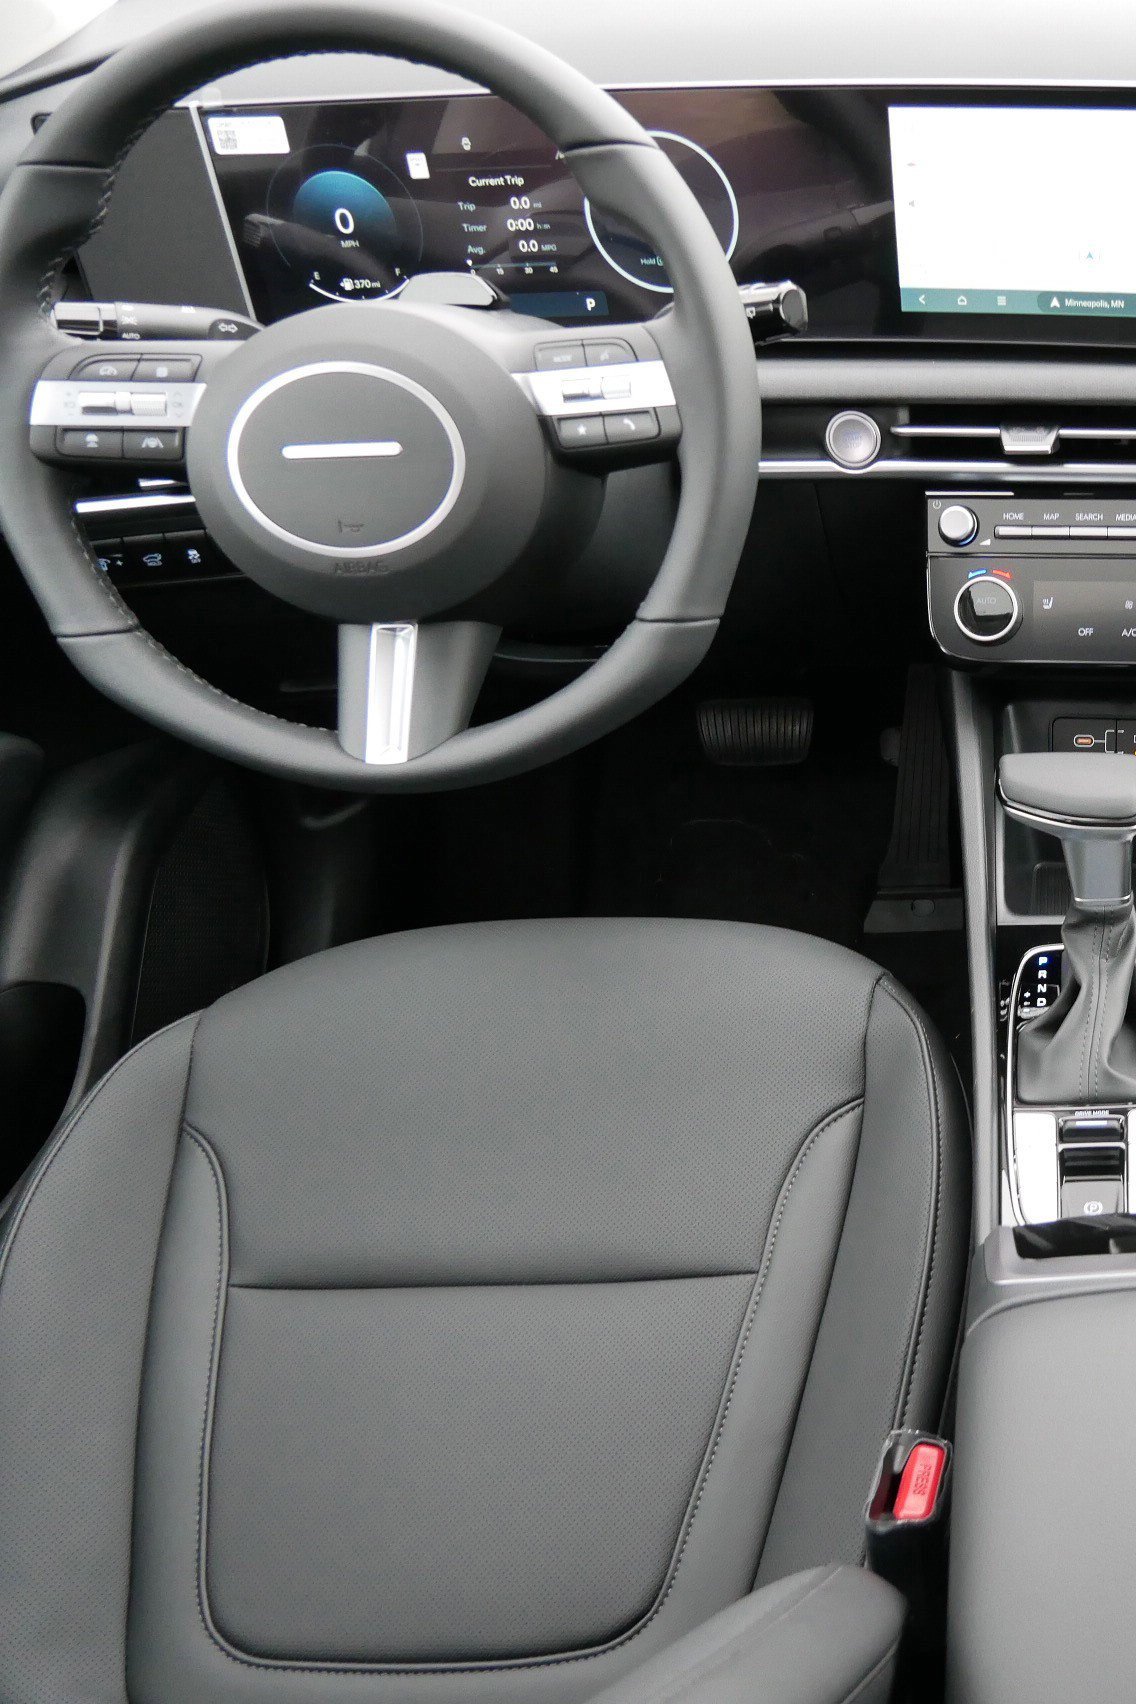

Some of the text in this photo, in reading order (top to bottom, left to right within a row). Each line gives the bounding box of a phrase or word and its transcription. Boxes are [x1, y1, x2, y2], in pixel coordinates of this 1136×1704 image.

[468, 175, 525, 187] Current Trip
[457, 201, 476, 212] Trip
[510, 196, 530, 210] 0.0
[334, 207, 355, 235] 0
[462, 223, 488, 233] Timer
[506, 218, 535, 232] 0:00
[340, 240, 360, 249] MPH
[467, 245, 486, 256] Avg.
[518, 239, 539, 253] 0.0
[355, 279, 372, 290] 370
[585, 297, 597, 312] P
[1065, 298, 1125, 309] Minneapolis, MN
[121, 332, 141, 341] AUTO
[1002, 512, 1025, 521] HOME
[1043, 512, 1060, 521] MAP
[1075, 513, 1104, 522] SEARCH
[1077, 627, 1094, 637] OFF
[1038, 956, 1048, 966] P
[1037, 969, 1048, 979] R
[1037, 983, 1047, 993] N
[1036, 997, 1047, 1007] D
